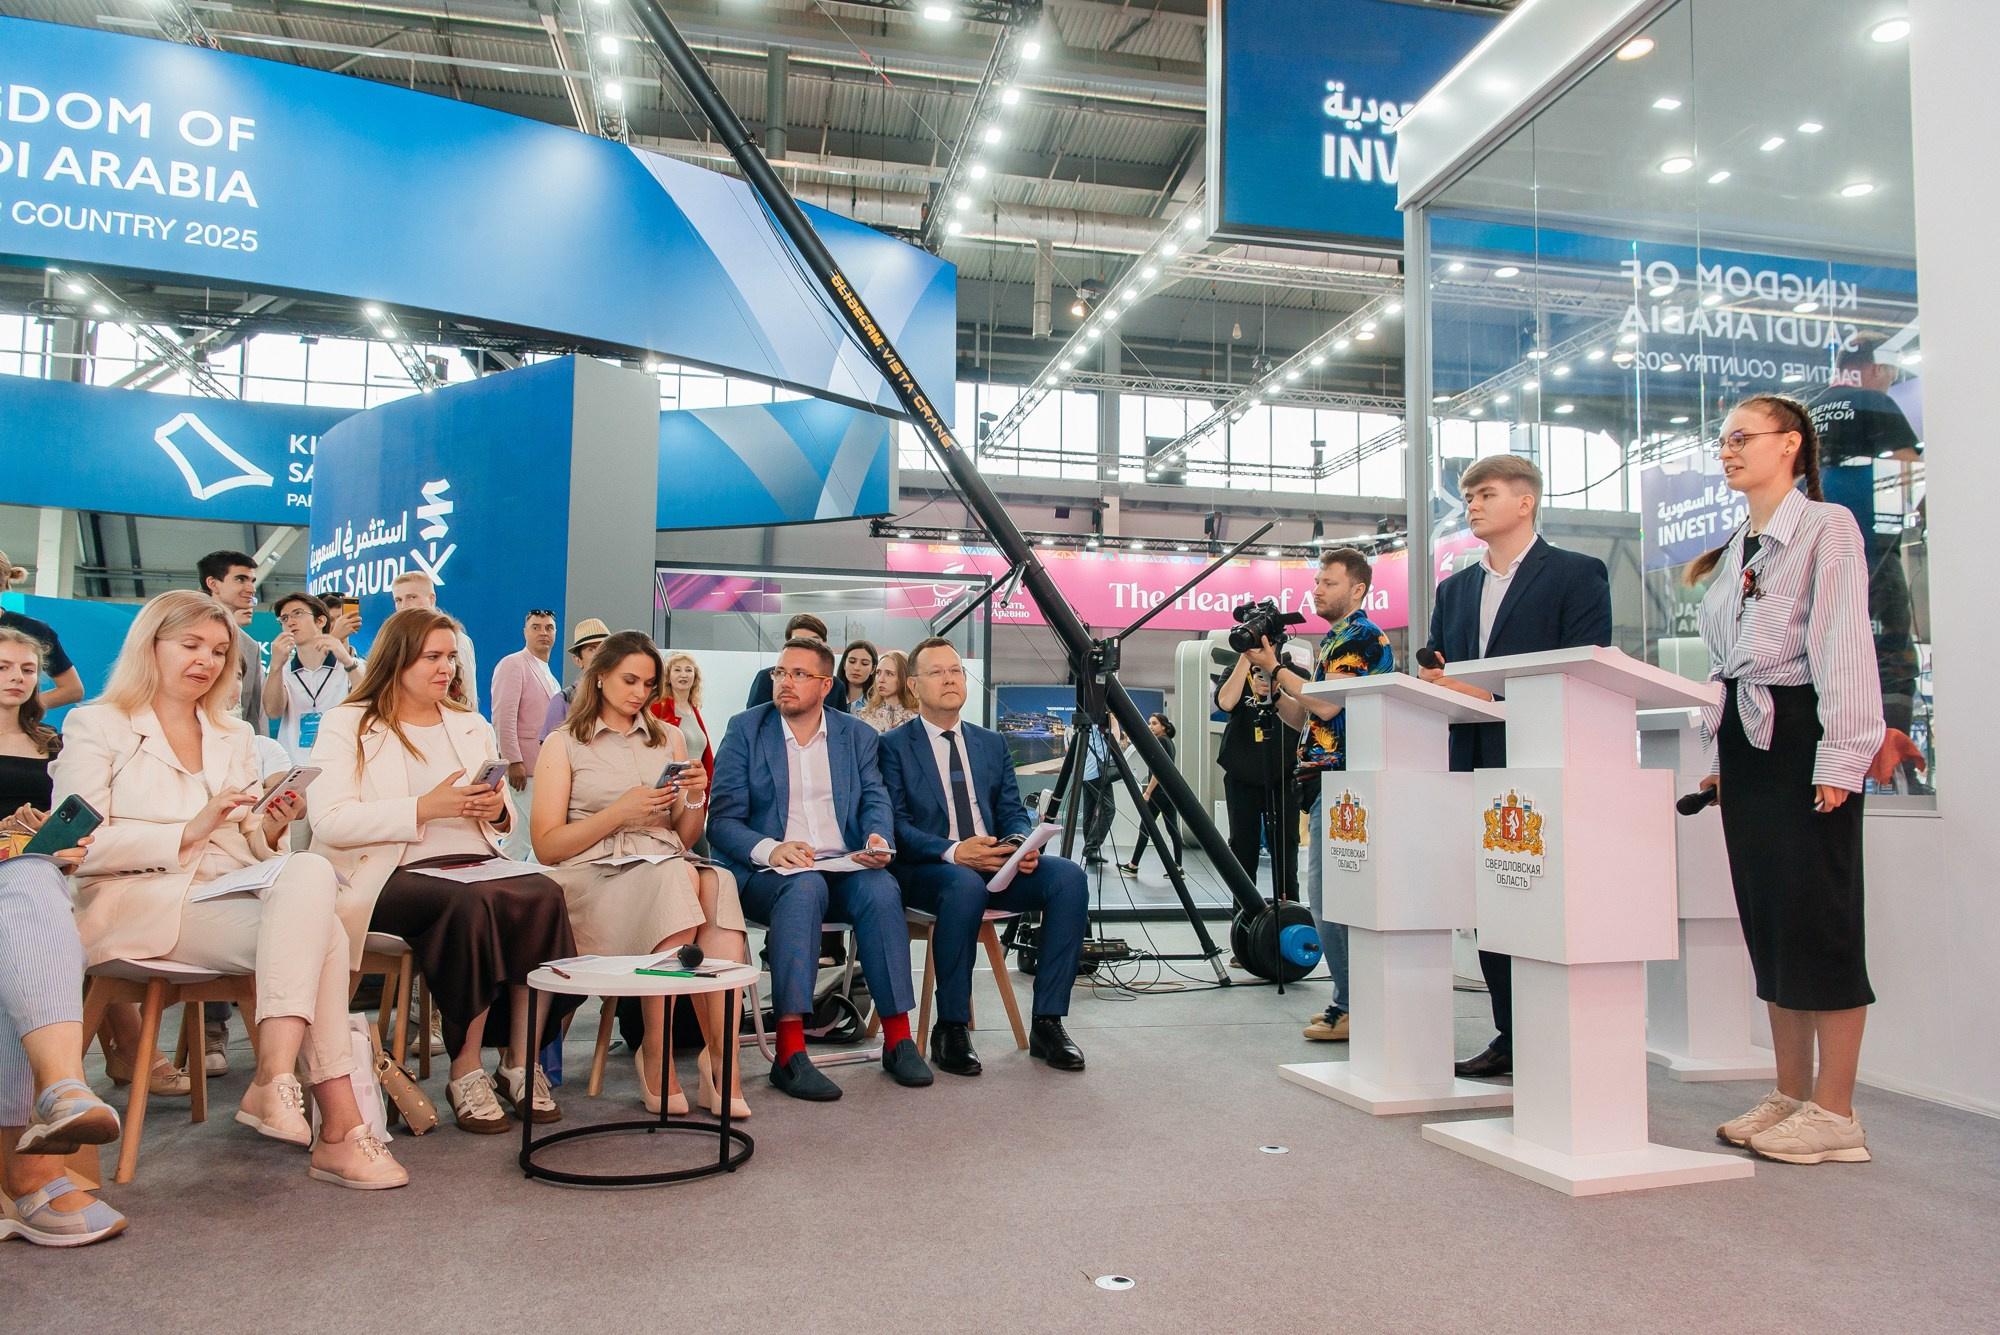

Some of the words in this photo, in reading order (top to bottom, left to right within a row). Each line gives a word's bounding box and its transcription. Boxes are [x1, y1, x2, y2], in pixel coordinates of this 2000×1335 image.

[0, 84, 151, 138] DOM
[178, 110, 255, 151] OF
[43, 146, 259, 208] ARABIA
[1324, 134, 1399, 184] INV
[11, 200, 177, 240] COUNTRY
[184, 221, 258, 251] 2025
[882, 347, 915, 395] VISTA
[913, 394, 953, 449] CRANE
[1807, 400, 1852, 418] ДЕНИЕ
[1811, 408, 1855, 425] ВСКОЙ
[355, 510, 407, 559] استثمر
[1658, 511, 1718, 547] INVEST
[1721, 502, 1750, 531] SA
[1108, 582, 1166, 609] The
[1330, 846, 1366, 859] СВЕРДЛОВСКАЯ
[1337, 859, 1358, 870] ОБЛАСТЬ
[1485, 858, 1541, 875] СВЕРДЛОВСКАЯ
[1496, 873, 1528, 888] ОБЛАСТЬ
